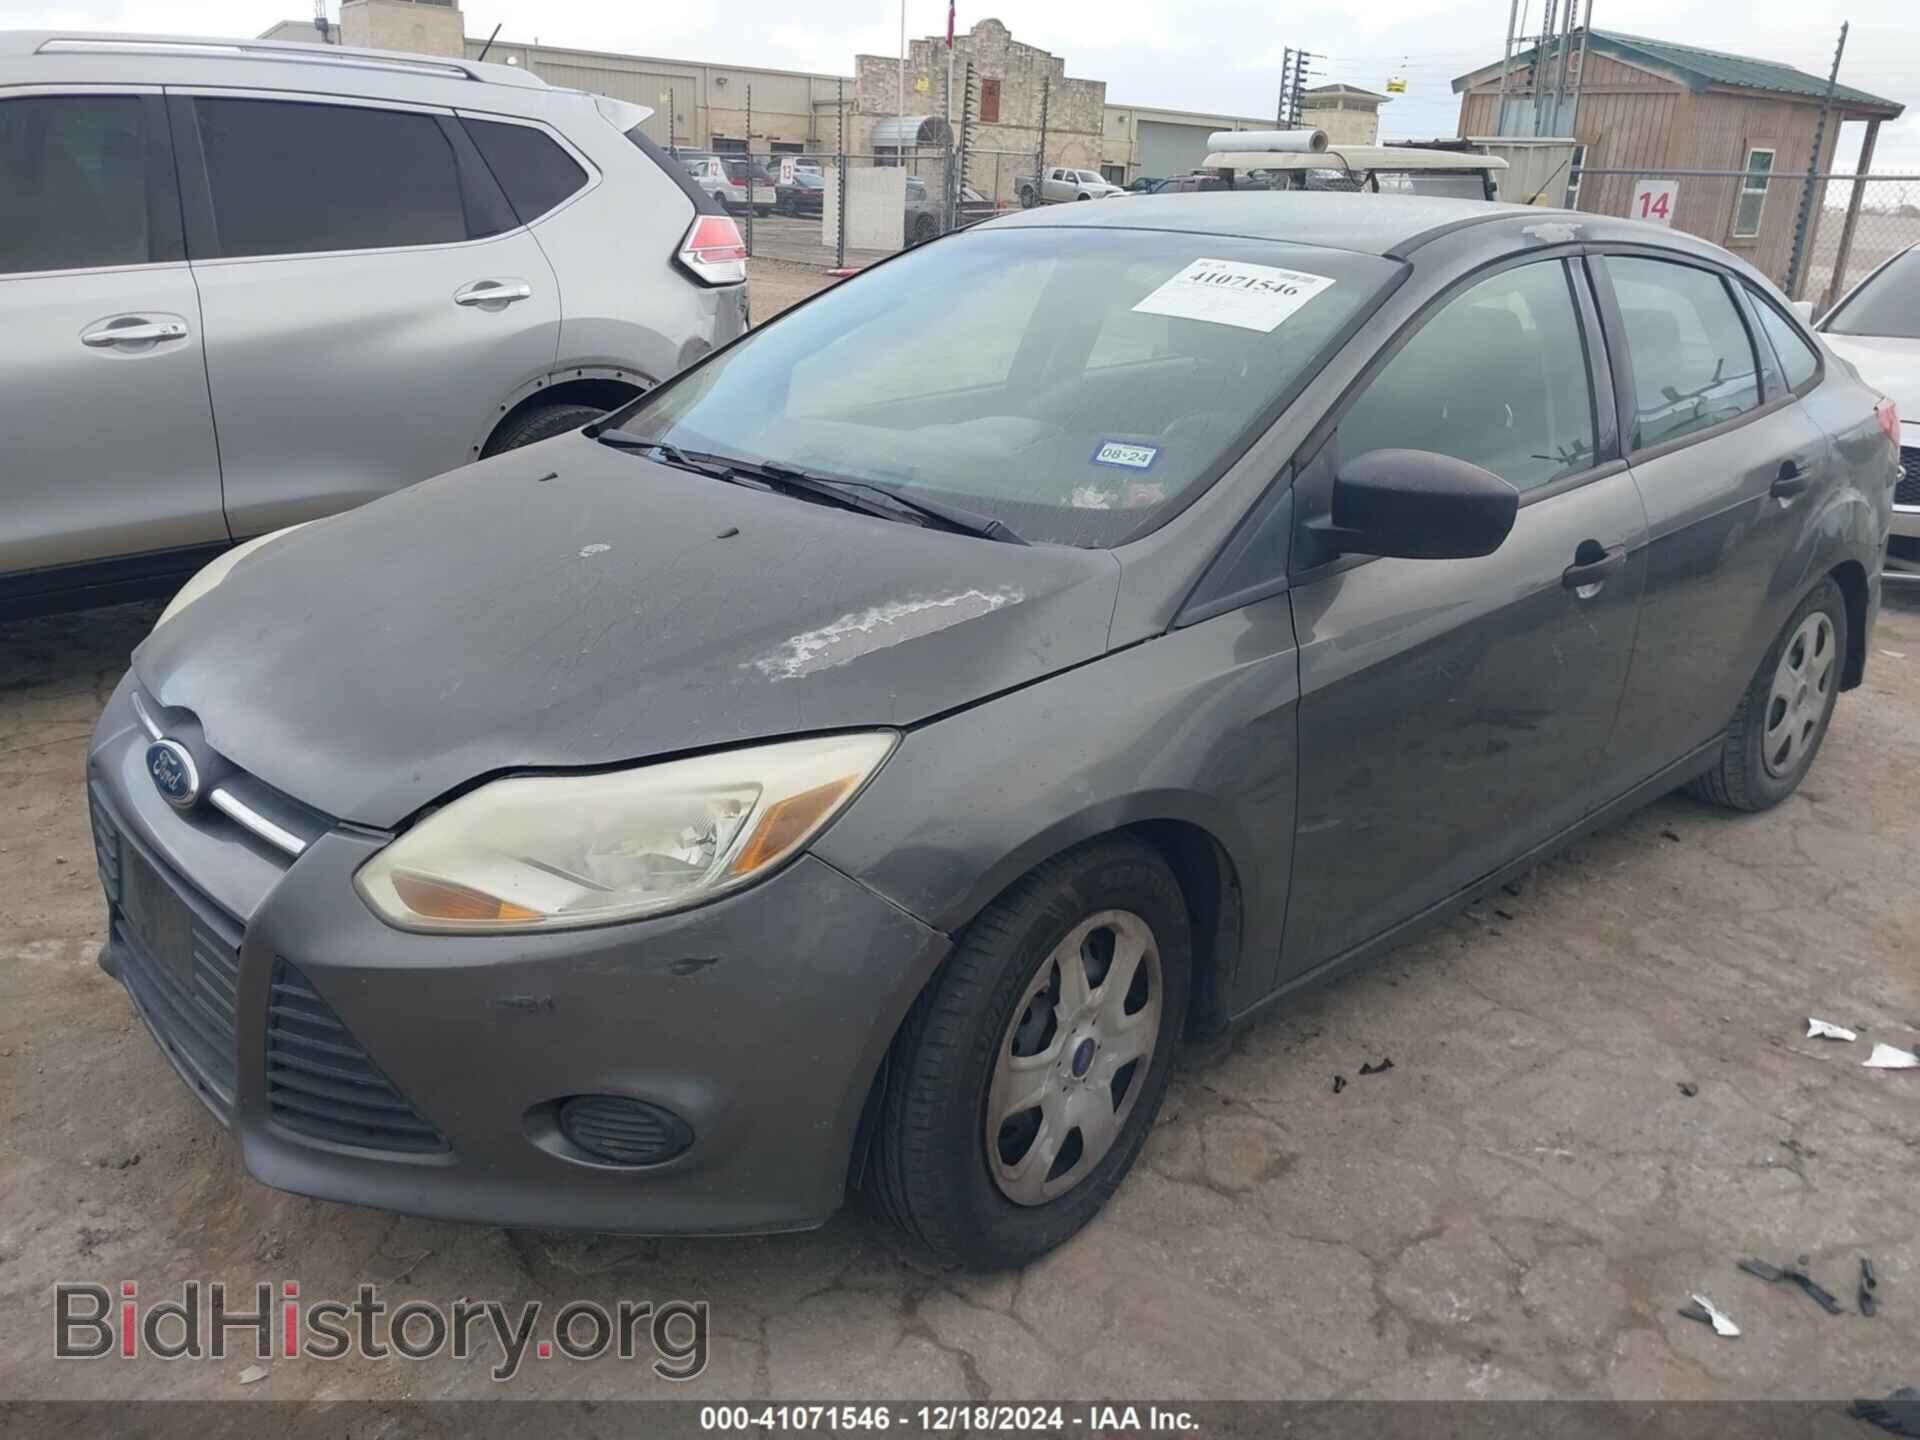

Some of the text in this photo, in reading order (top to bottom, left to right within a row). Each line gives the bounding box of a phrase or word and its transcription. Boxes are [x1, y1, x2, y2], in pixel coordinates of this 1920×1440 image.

[1640, 192, 1669, 219] 14
[1190, 271, 1298, 296] 41071546
[152, 749, 182, 791] Ford
